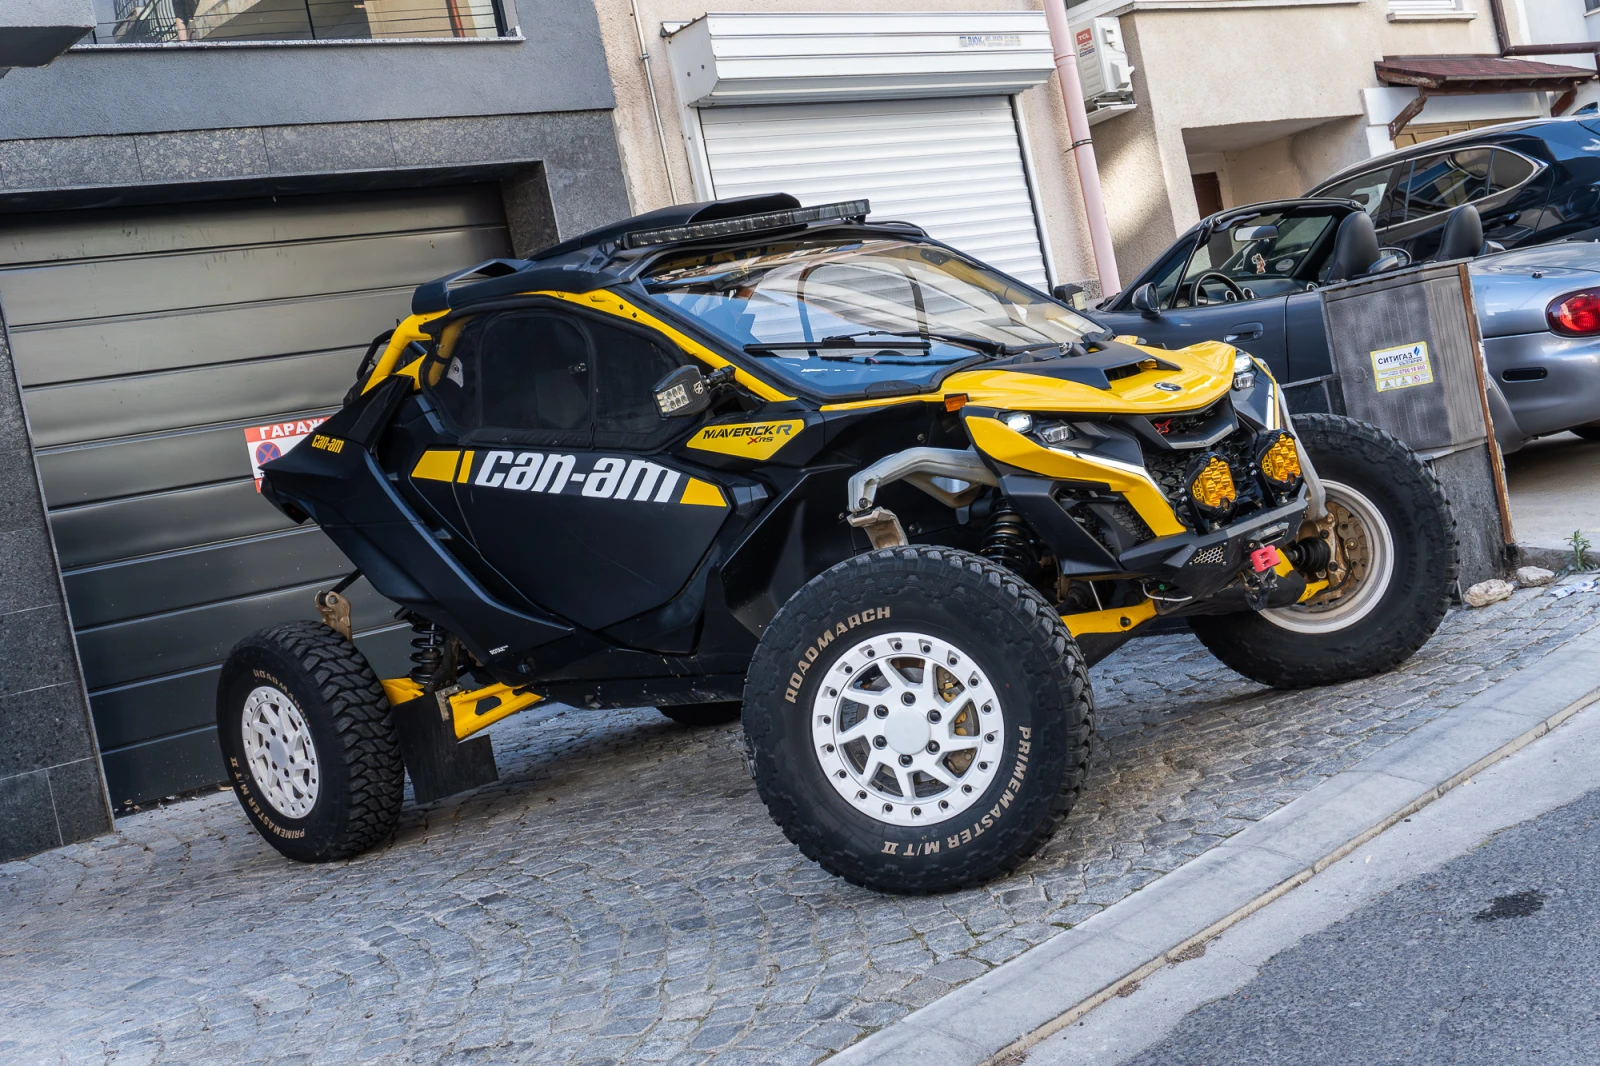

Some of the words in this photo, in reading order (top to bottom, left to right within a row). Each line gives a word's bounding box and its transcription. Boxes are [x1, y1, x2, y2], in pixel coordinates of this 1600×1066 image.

[1078, 33, 1090, 41] TCL
[1378, 352, 1413, 364] СИТИГАЗ
[703, 425, 776, 439] MAVERICK
[776, 424, 792, 435] R
[747, 436, 774, 445] XRS
[785, 606, 891, 704] ROADMARCH
[947, 725, 1032, 849] PRIMEMASTER
[248, 797, 305, 839] PRIMEMASTER
[903, 840, 940, 856] M/T
